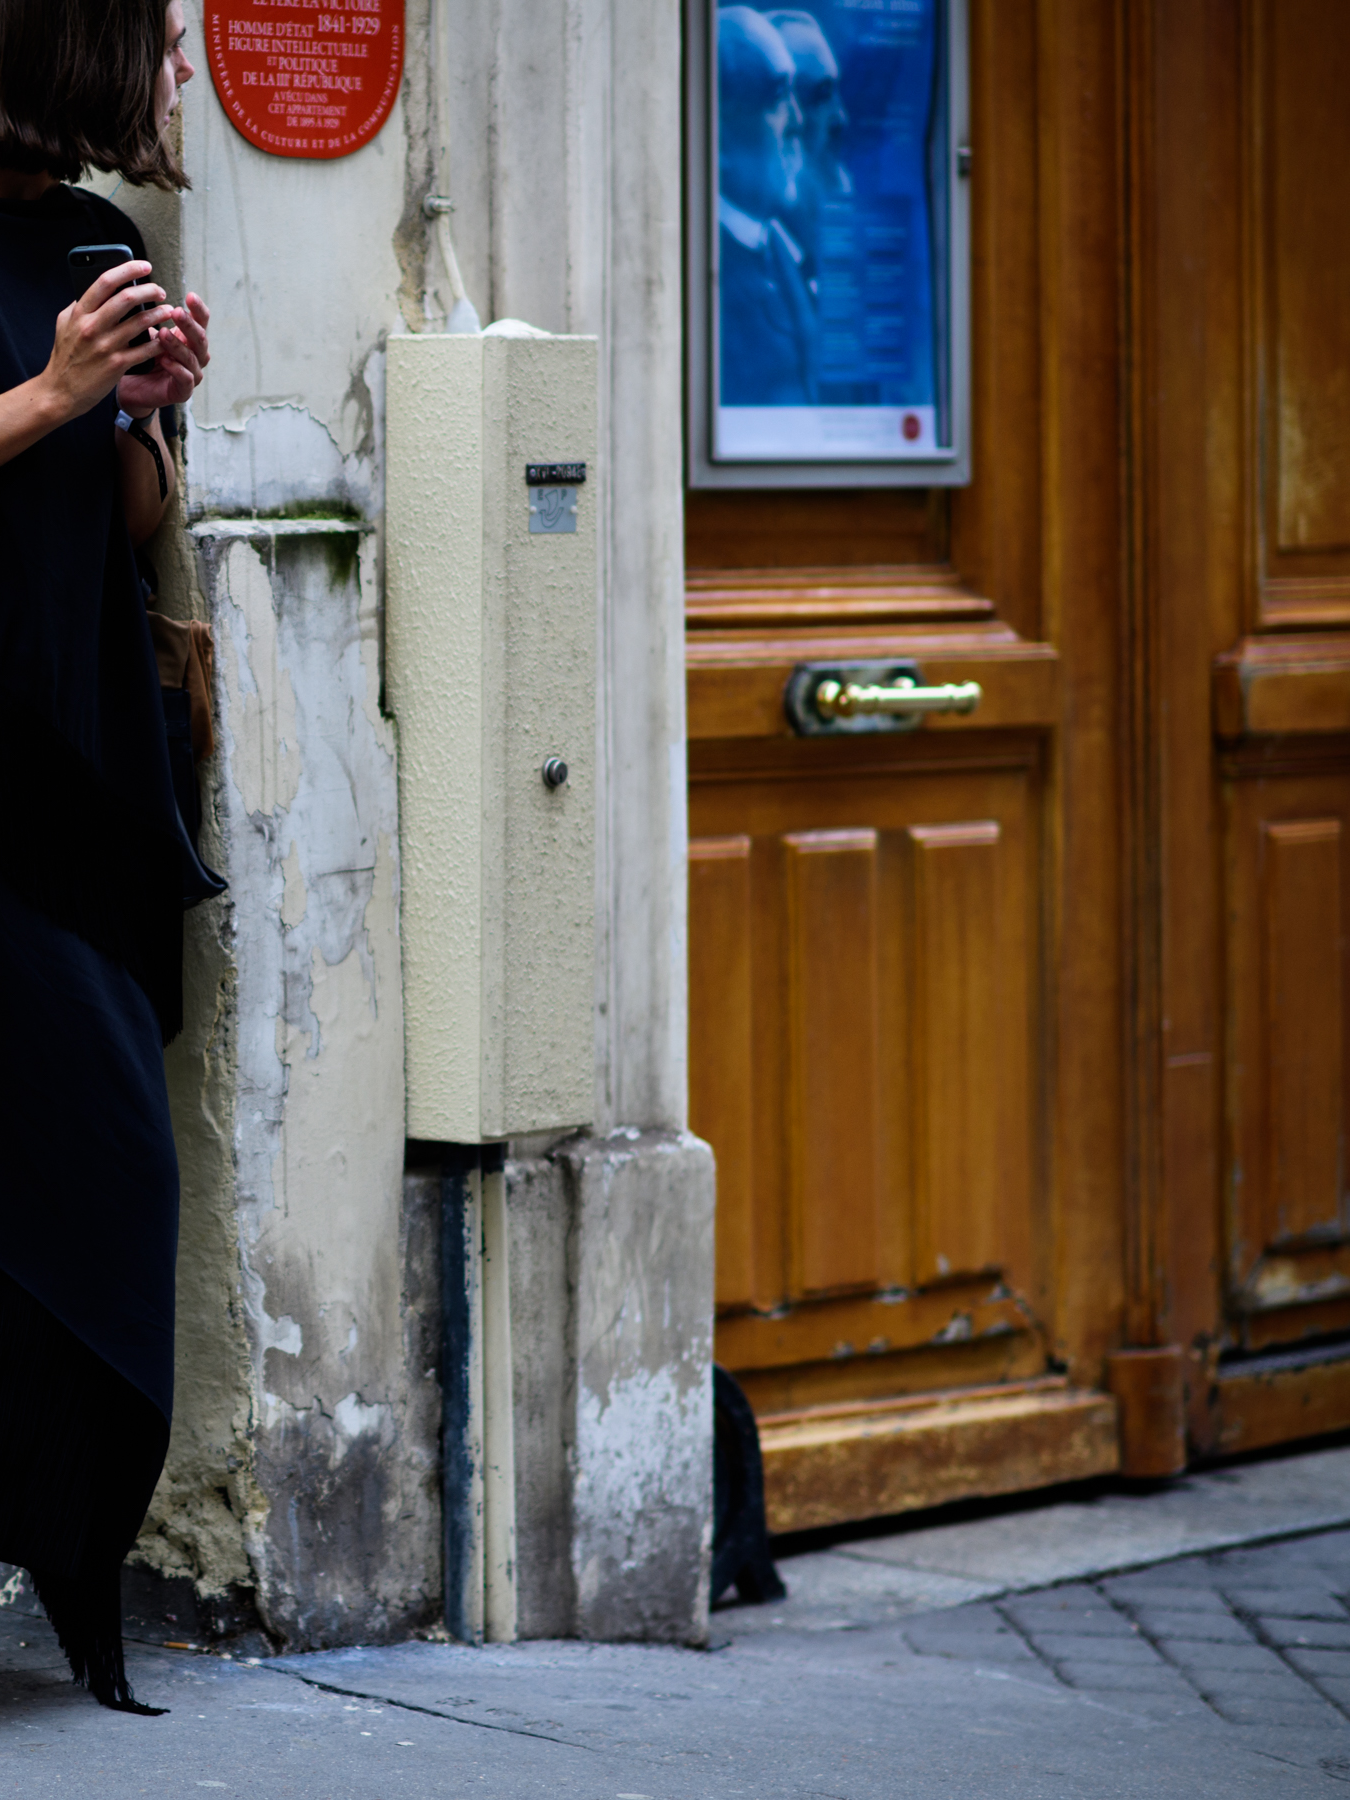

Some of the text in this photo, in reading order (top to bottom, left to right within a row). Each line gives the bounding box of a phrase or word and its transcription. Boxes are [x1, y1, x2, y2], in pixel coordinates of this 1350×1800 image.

[228, 20, 315, 39] HOMME D'ÉTAT
[317, 14, 381, 36] 1841-1929
[228, 37, 368, 58] FIGURE INTELLECTUELLE
[267, 56, 339, 76] ET POLITIQUE
[232, 101, 245, 118] DE
[245, 118, 258, 134] LA
[260, 130, 308, 149] CULTURE
[311, 139, 325, 149] ET
[327, 137, 341, 149] DE
[343, 132, 357, 145] LA
[357, 24, 400, 136] COMMUNICATION
[242, 71, 258, 86] DE
[259, 72, 276, 88] LA
[293, 72, 363, 94] RÉPUBLIQUE
[273, 90, 328, 104] A VÉCU DANS
[267, 103, 347, 117] CET APPARTEMENT
[286, 116, 298, 127] DE
